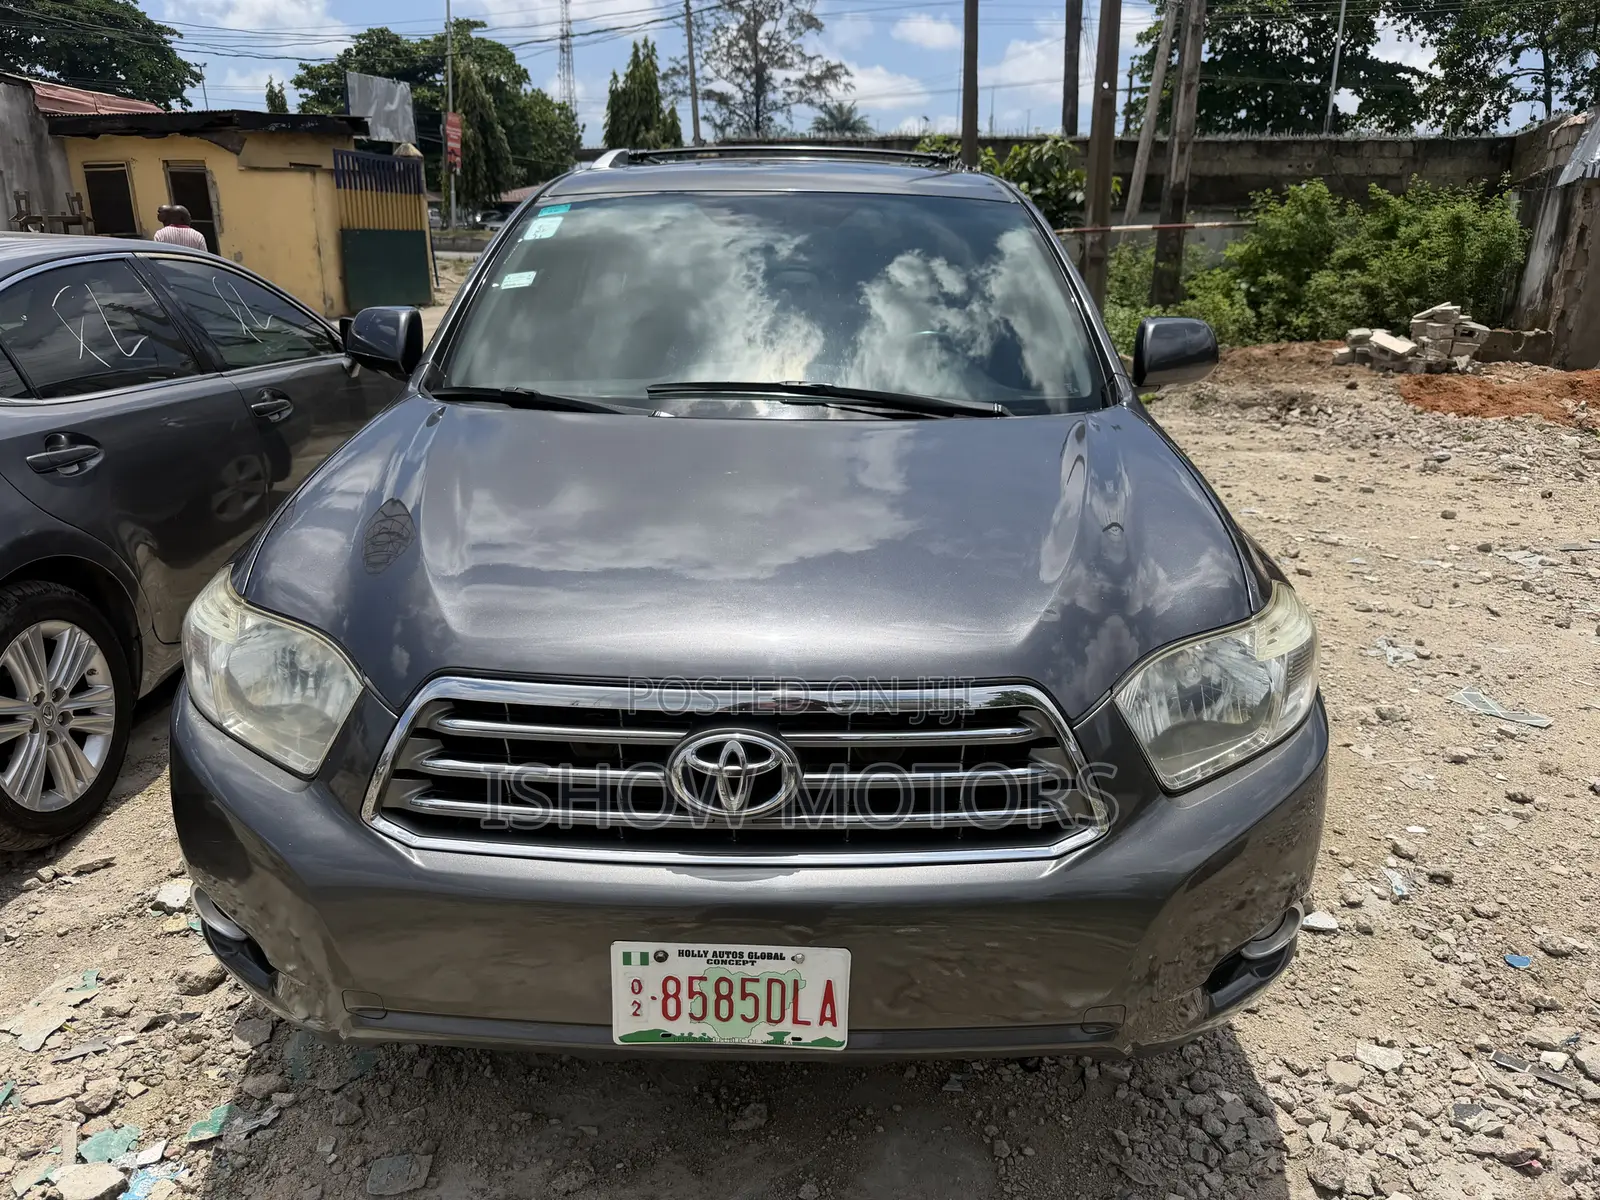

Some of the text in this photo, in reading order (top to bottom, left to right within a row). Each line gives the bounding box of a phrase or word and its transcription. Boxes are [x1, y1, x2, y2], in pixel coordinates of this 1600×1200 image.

[678, 949, 786, 961] HOLLY AUTOS GLOBAL
[706, 959, 757, 967] CONCEPT
